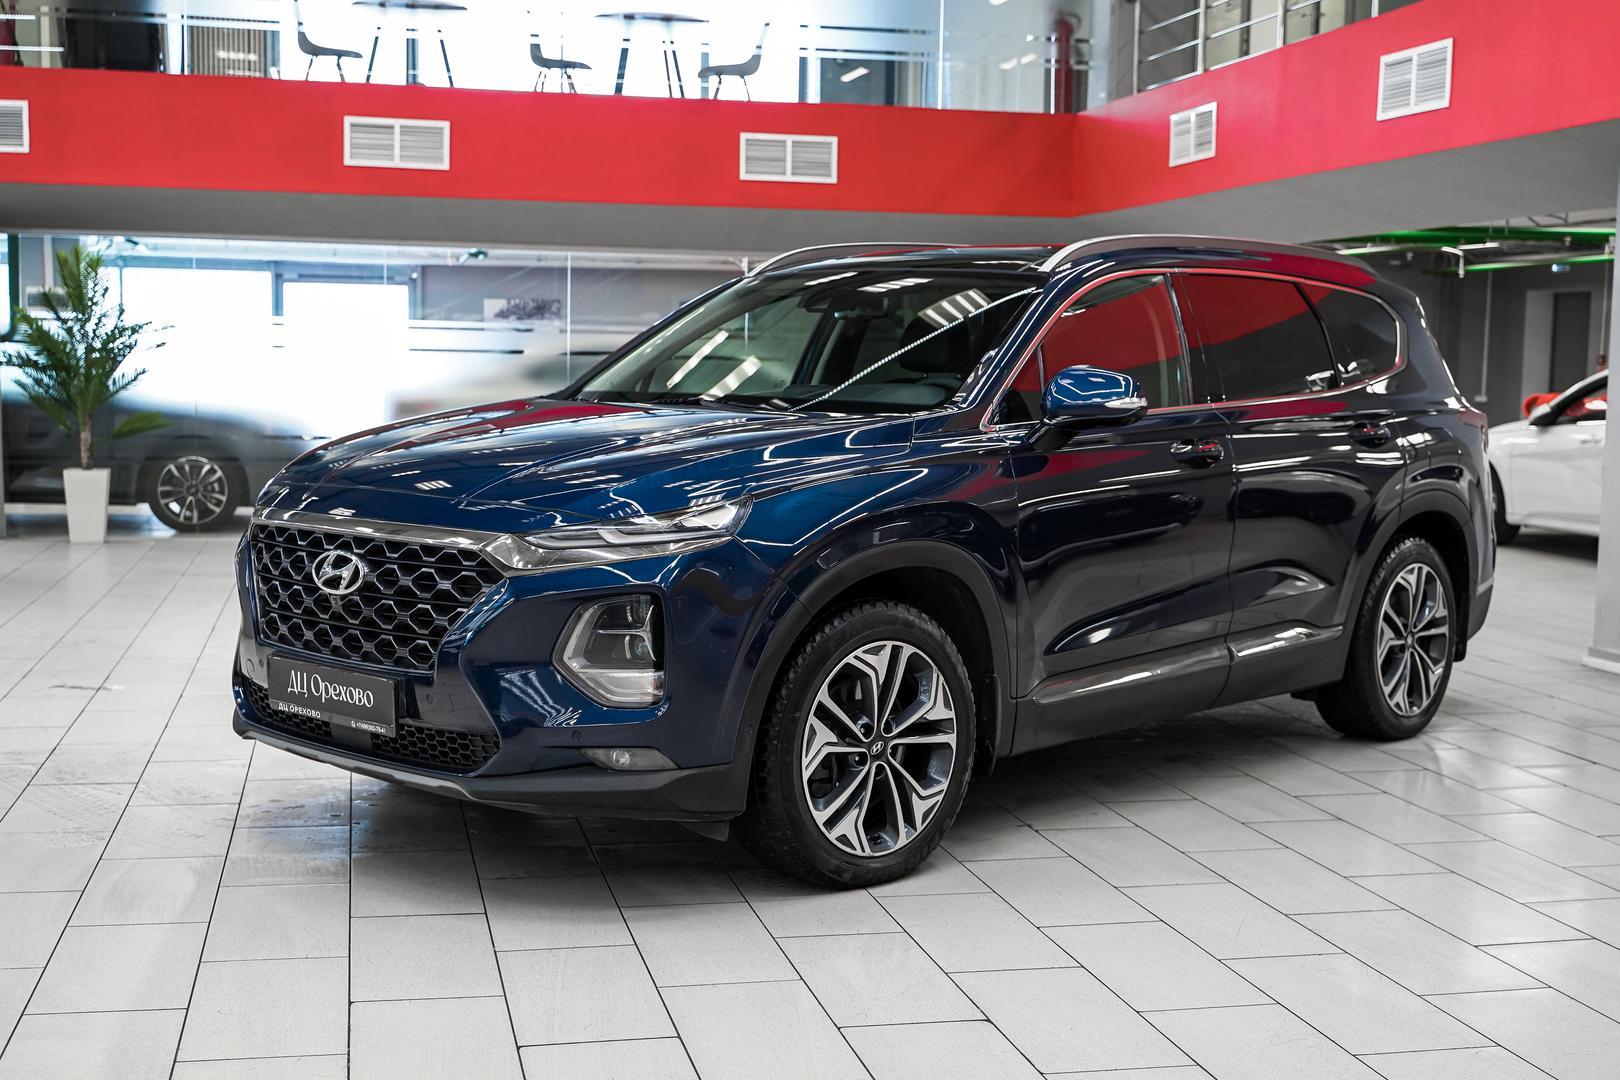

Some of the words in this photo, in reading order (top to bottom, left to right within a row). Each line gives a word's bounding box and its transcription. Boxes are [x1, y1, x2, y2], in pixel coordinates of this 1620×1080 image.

[288, 669, 308, 698] ДЦ
[311, 674, 374, 708] Орехово
[278, 702, 289, 712] ДЦ
[289, 706, 321, 718] ОРЕХОВО
